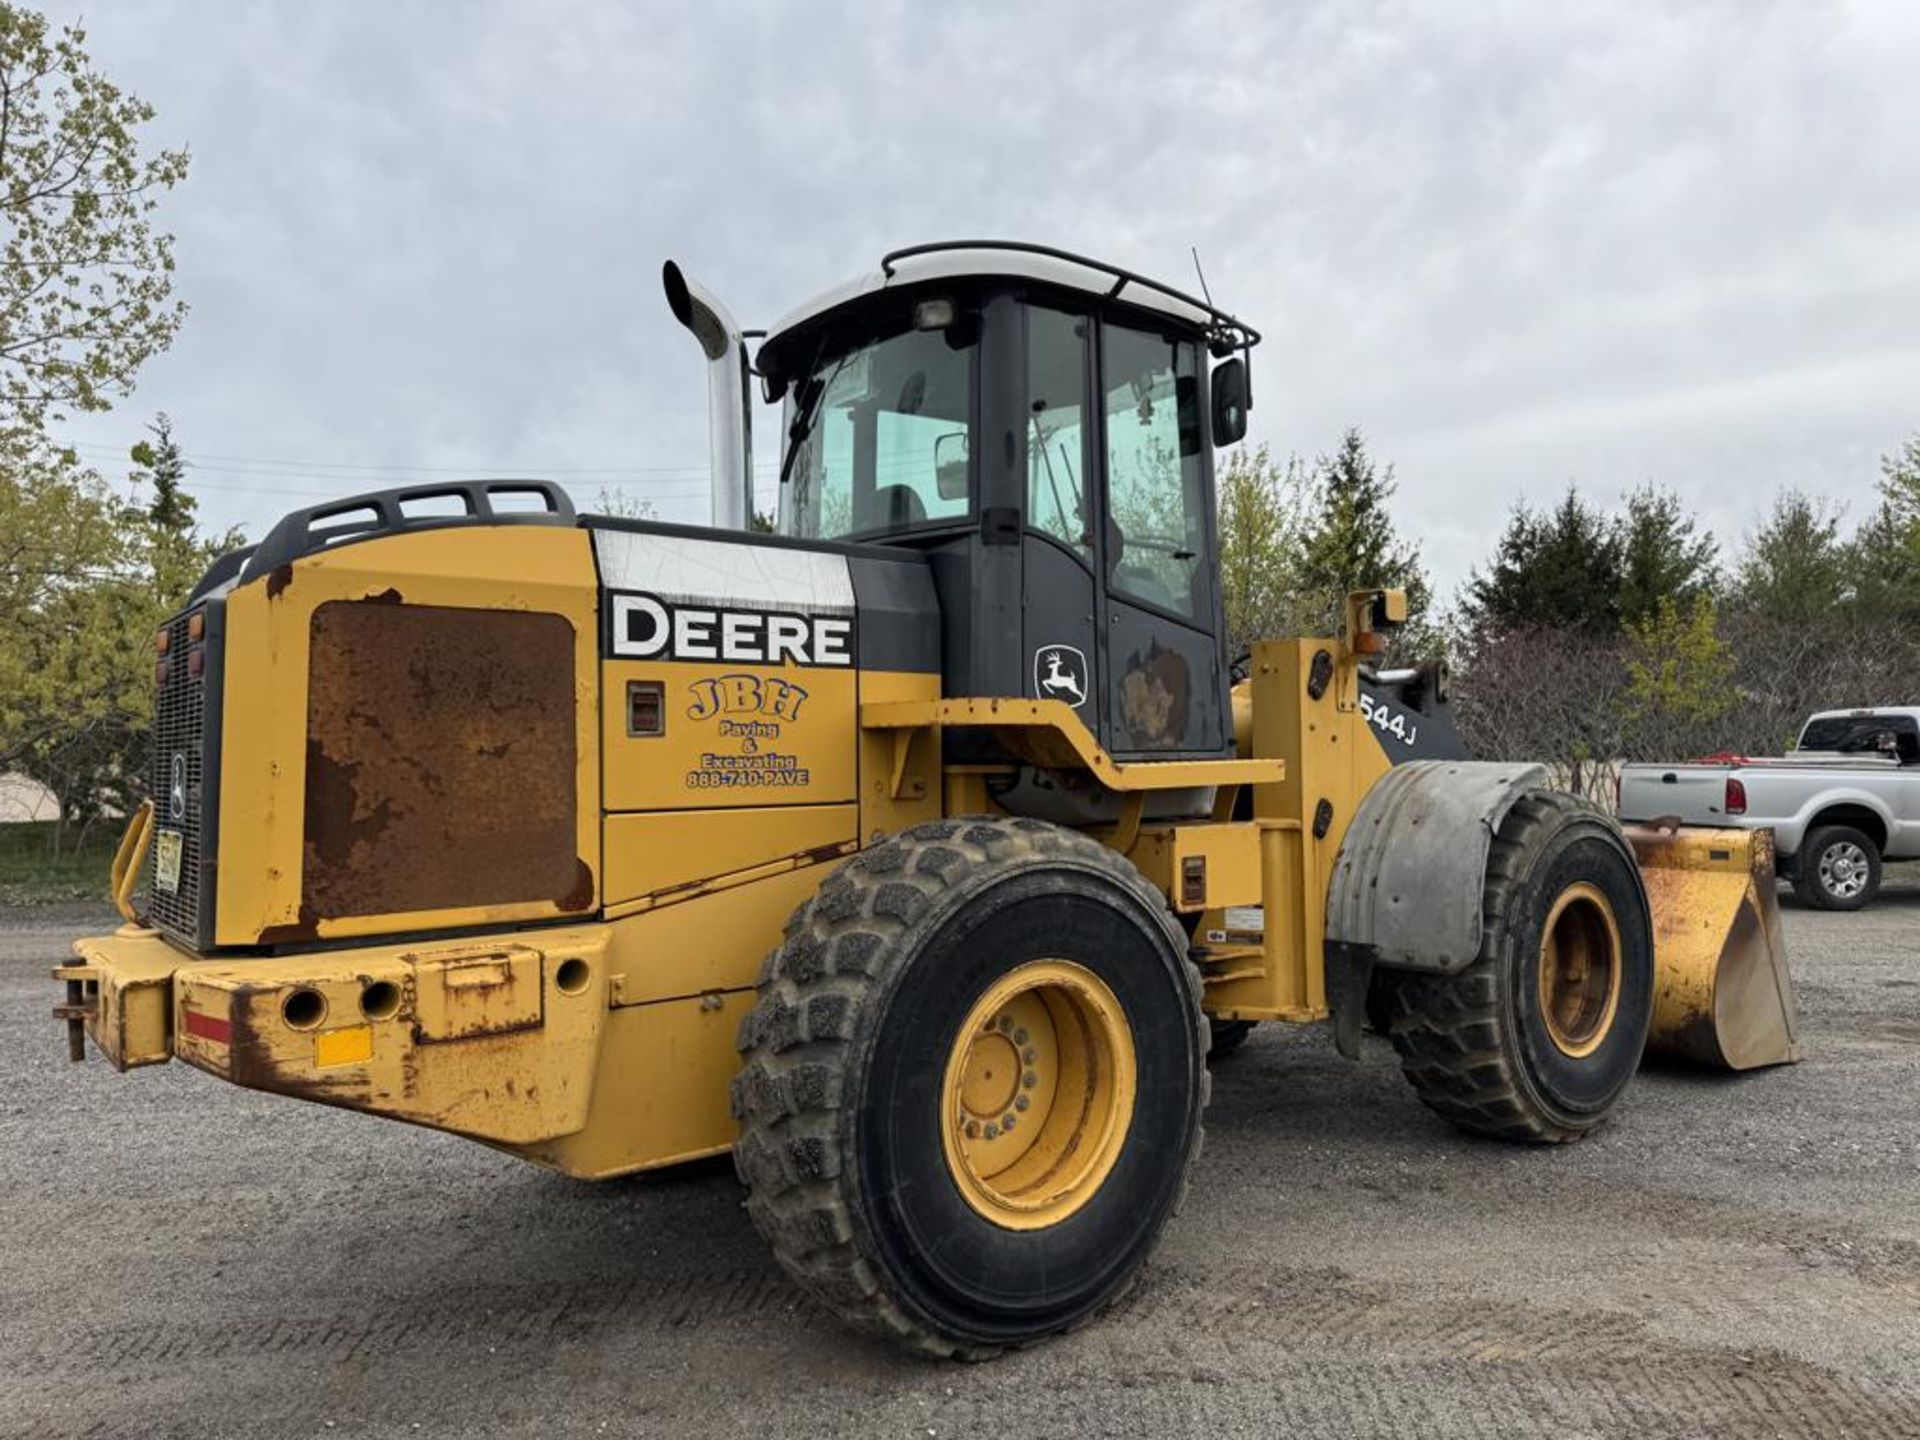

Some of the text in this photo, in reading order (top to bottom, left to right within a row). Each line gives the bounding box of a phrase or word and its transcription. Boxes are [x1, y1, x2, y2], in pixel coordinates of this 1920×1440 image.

[613, 594, 850, 664] DEERE
[688, 675, 808, 721] JBH
[720, 720, 779, 738] Paving
[743, 738, 758, 753] &
[702, 754, 796, 771] Excavating
[687, 769, 809, 788] 888-740-PAVE
